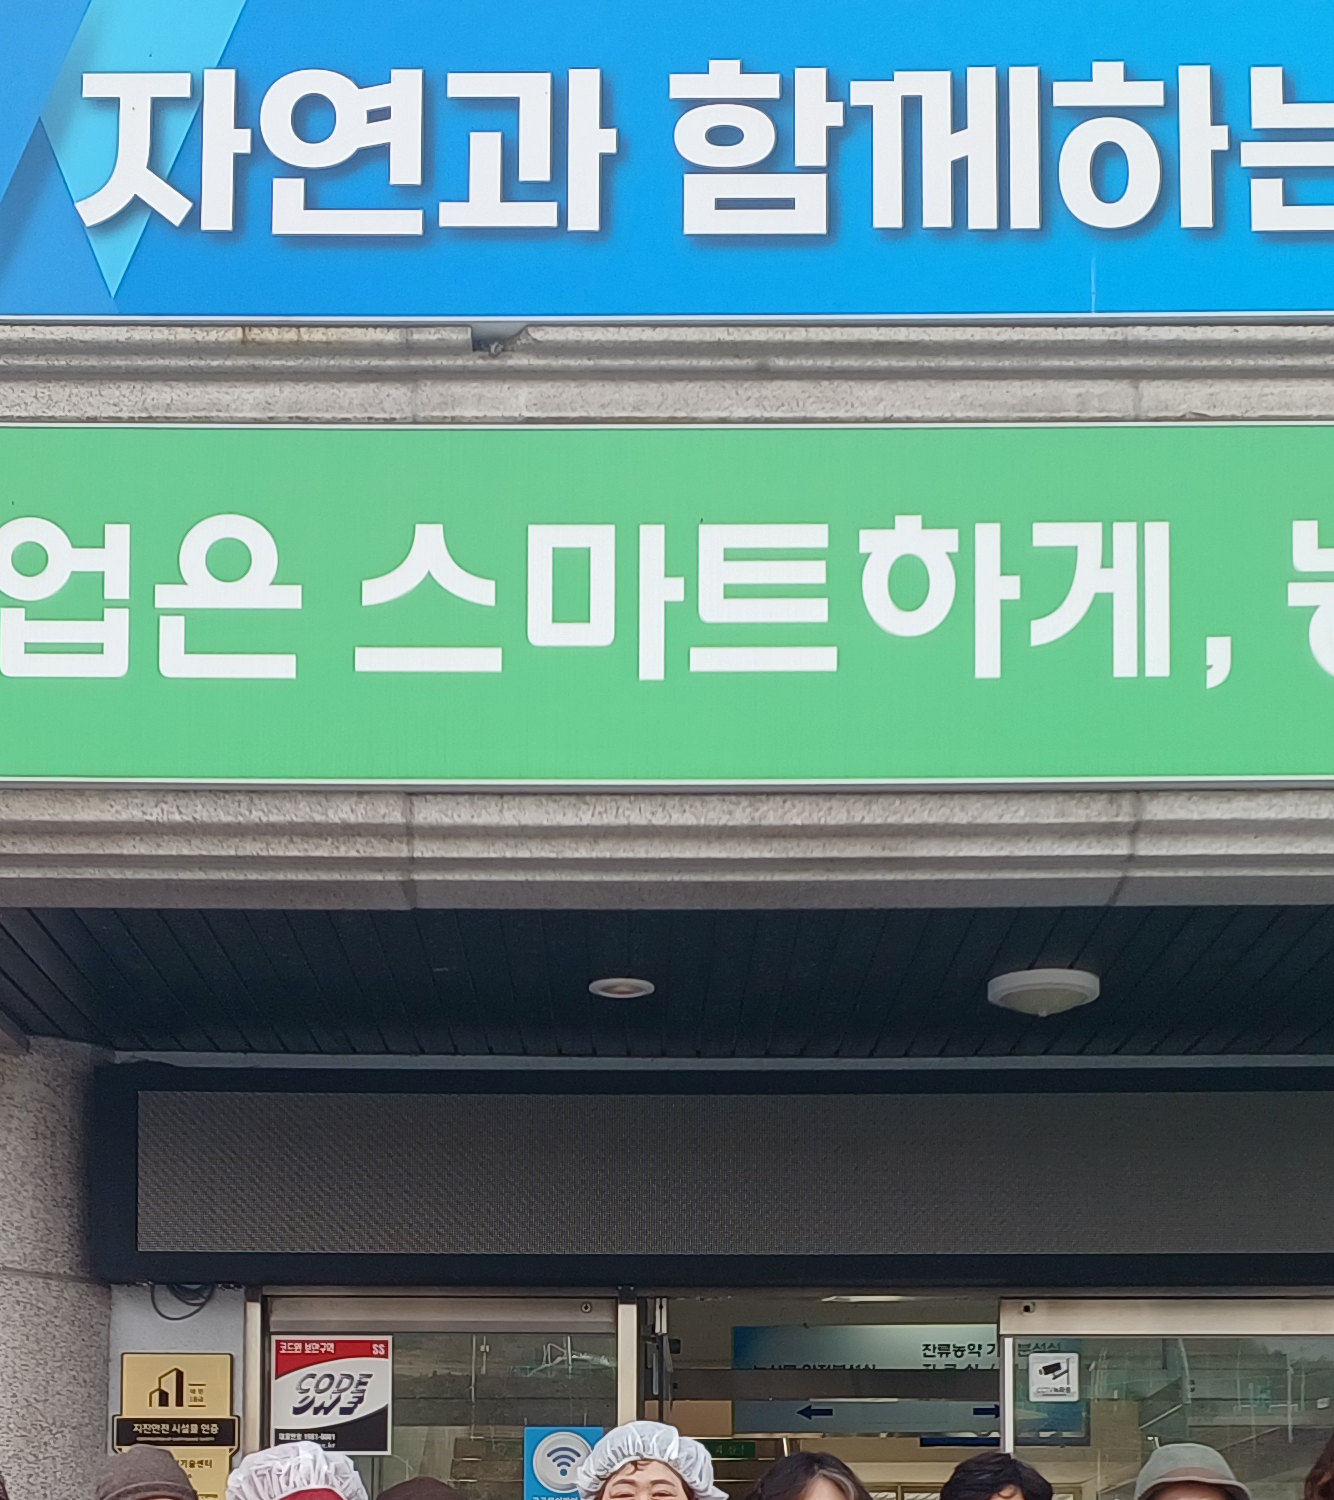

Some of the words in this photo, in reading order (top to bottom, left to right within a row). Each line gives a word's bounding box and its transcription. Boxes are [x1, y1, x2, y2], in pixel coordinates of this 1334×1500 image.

[75, 65, 620, 236] 자연과
[353, 513, 1234, 691] 스마트하게,
[372, 1343, 386, 1355] SS
[921, 1343, 983, 1358] 잔류농약
[295, 1373, 374, 1394] CODE
[291, 1393, 367, 1416] ONE
[133, 1423, 170, 1434] 지진안전
[172, 1423, 199, 1434] 시설물
[177, 1459, 213, 1469] 기술센터
